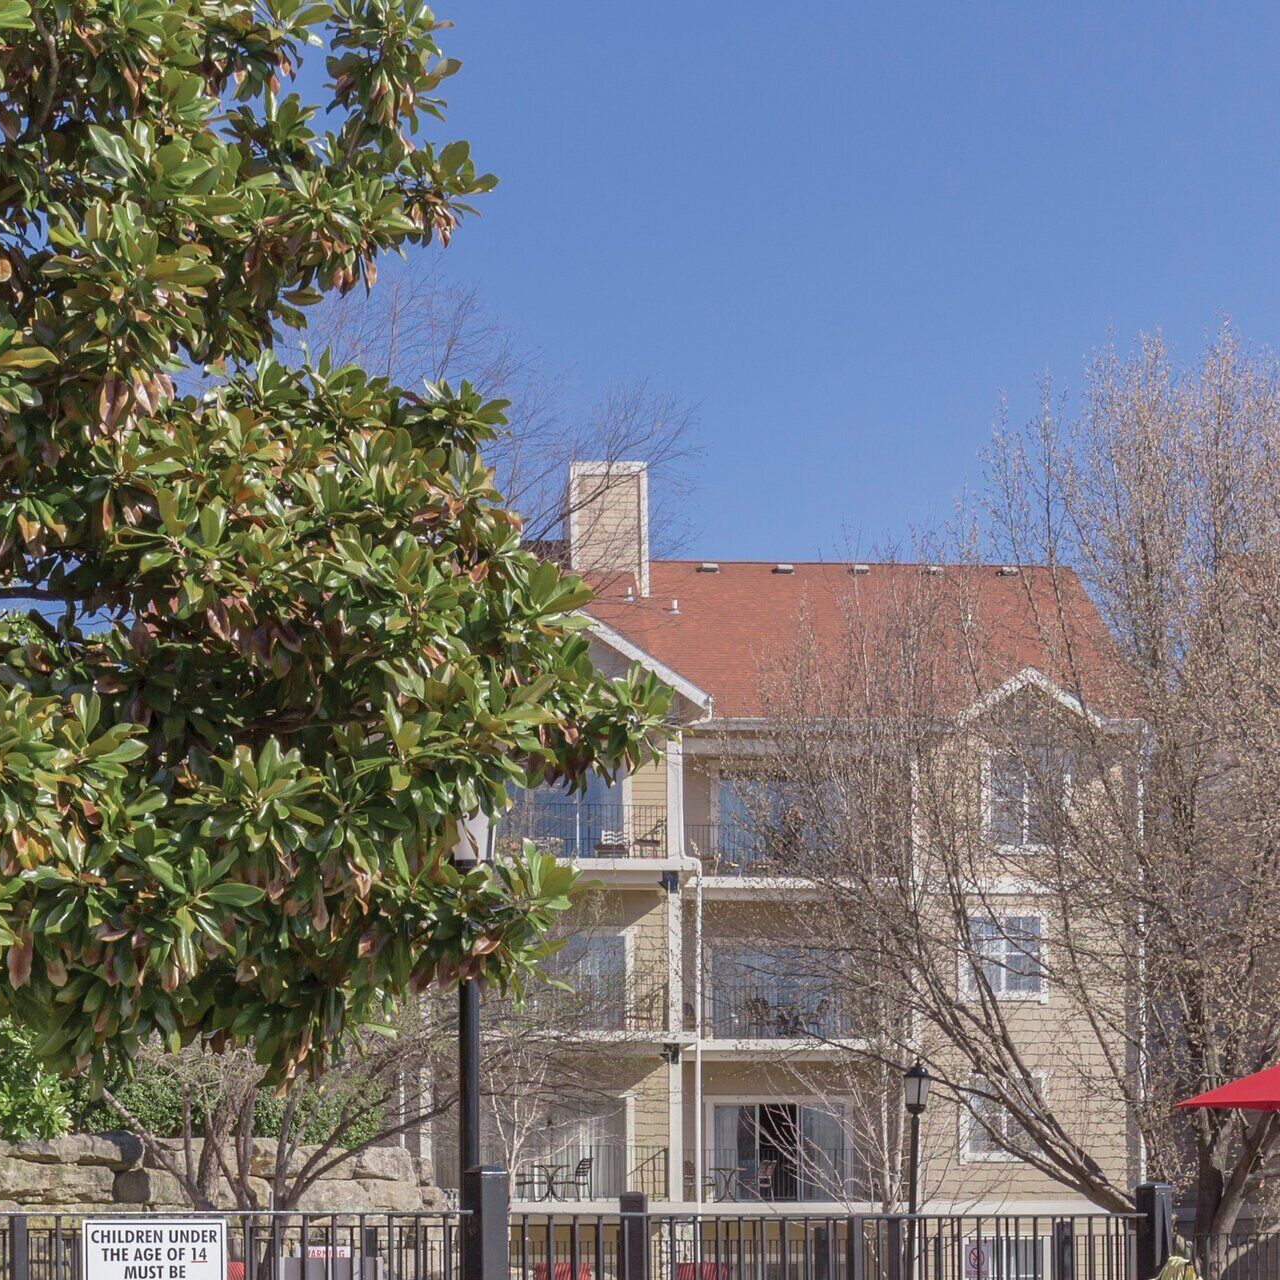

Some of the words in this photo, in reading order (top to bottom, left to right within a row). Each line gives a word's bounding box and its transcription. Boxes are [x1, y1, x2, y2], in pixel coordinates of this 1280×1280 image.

[91, 1230, 163, 1243] CHILDREN
[169, 1230, 217, 1243] UNDER
[102, 1248, 129, 1261] THE
[134, 1248, 162, 1261] AGE
[167, 1248, 185, 1261] OF
[191, 1248, 207, 1261] 14
[306, 1249, 345, 1258] ARNIG
[124, 1266, 164, 1279] MUST
[169, 1265, 186, 1278] BE
